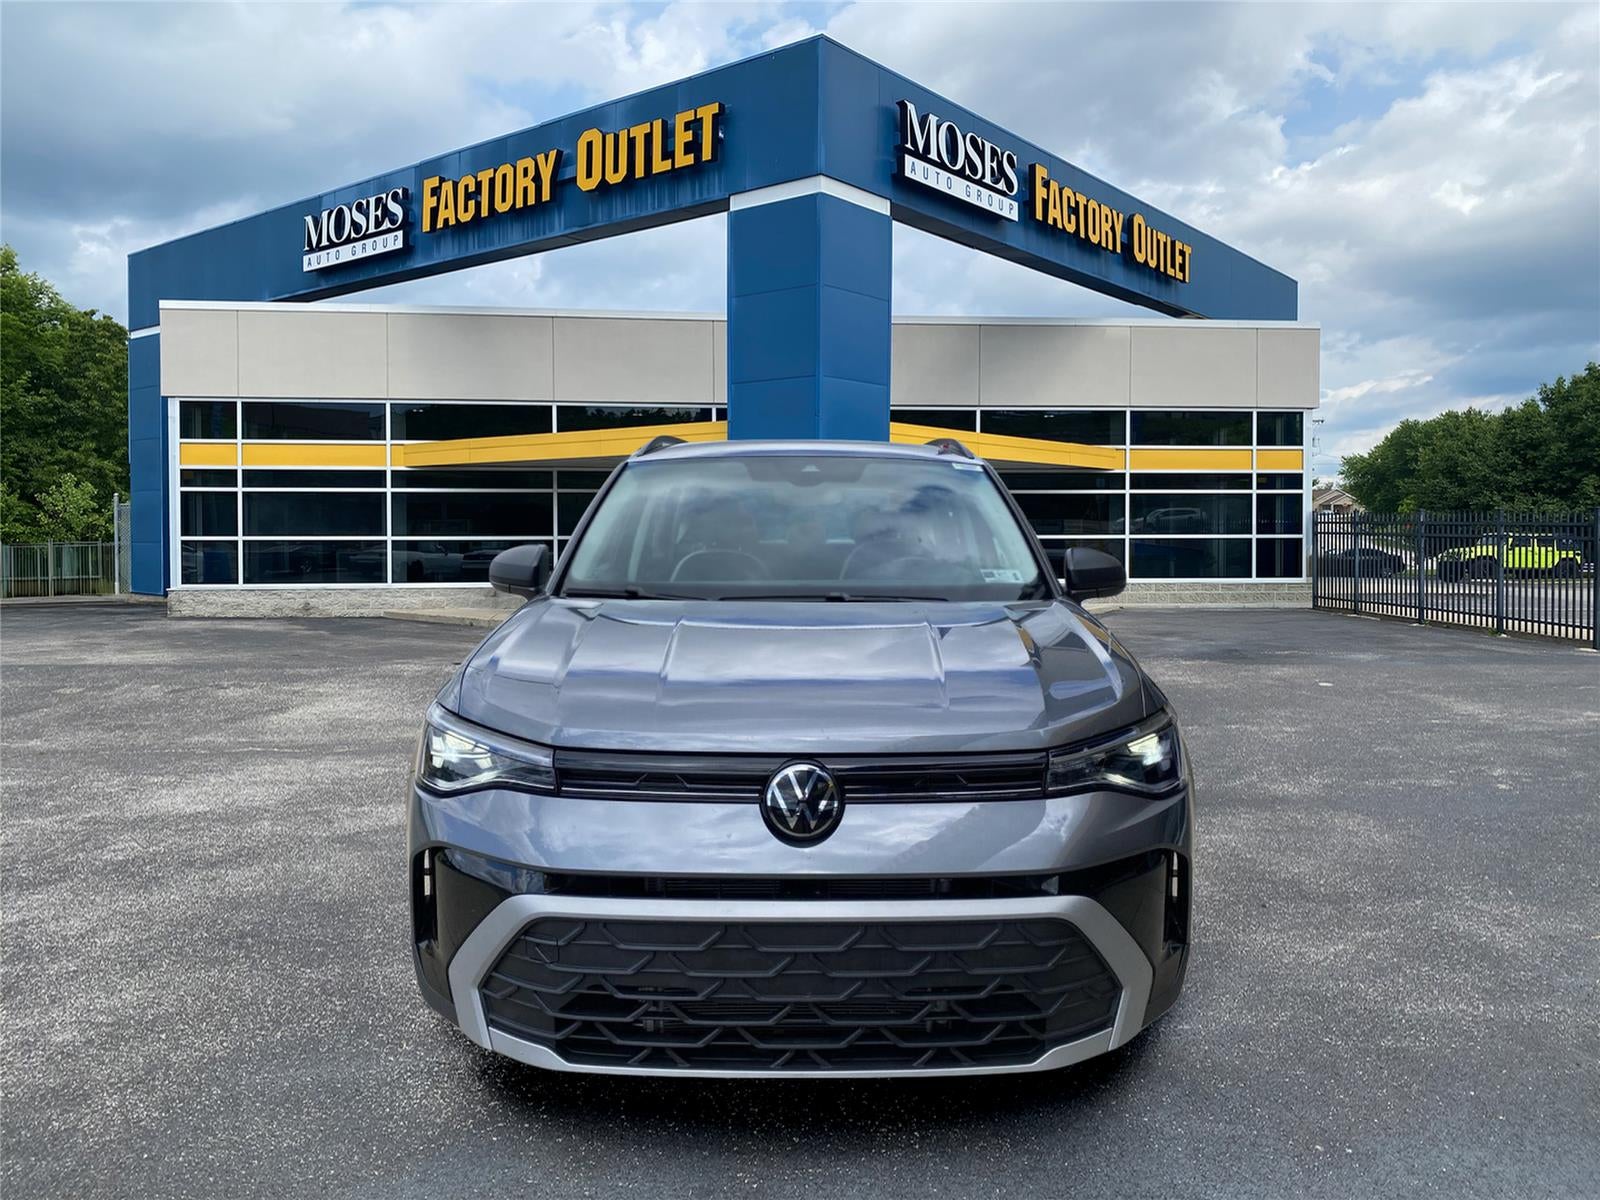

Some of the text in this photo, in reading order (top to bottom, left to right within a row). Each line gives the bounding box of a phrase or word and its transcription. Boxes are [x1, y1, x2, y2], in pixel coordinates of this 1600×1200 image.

[421, 102, 720, 233] FACTORY OUTLET
[903, 100, 1018, 196] MOSES
[910, 161, 1014, 214] AUTO GROUP
[303, 188, 403, 251] MOSES
[307, 234, 399, 267] AUTO GROUP
[1034, 163, 1192, 283] FACTORY OUTLET
